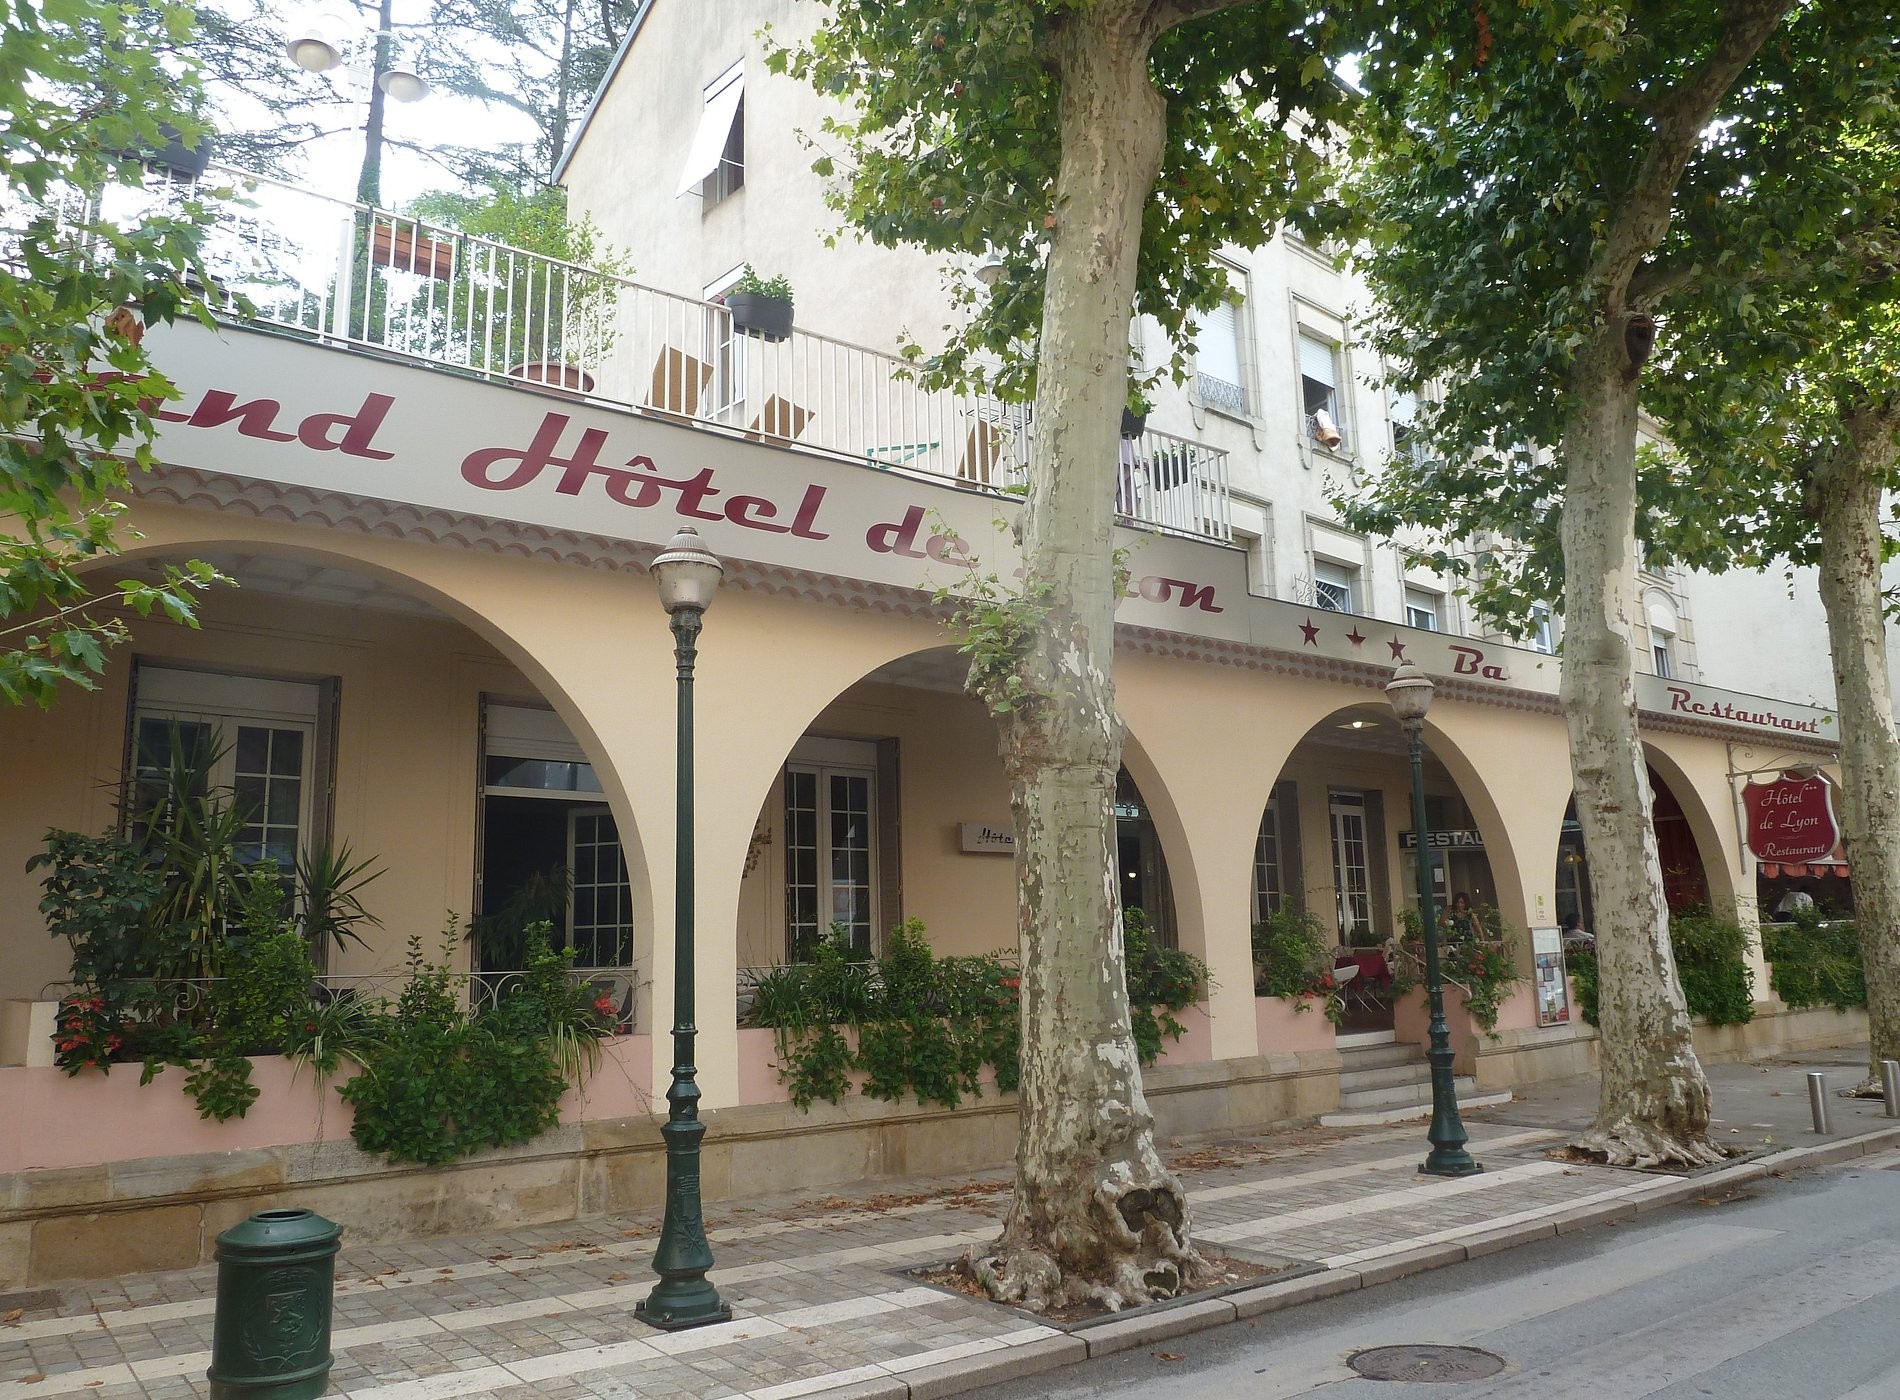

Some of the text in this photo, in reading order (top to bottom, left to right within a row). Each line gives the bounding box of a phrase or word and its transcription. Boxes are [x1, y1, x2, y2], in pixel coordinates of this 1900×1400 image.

[461, 412, 830, 541] Hôtel
[866, 505, 981, 568] de
[1667, 687, 1820, 734] Restaurant
[1761, 784, 1809, 807] Hôtel
[1760, 810, 1818, 833] de Lyon
[1760, 842, 1825, 858] Restaurant
